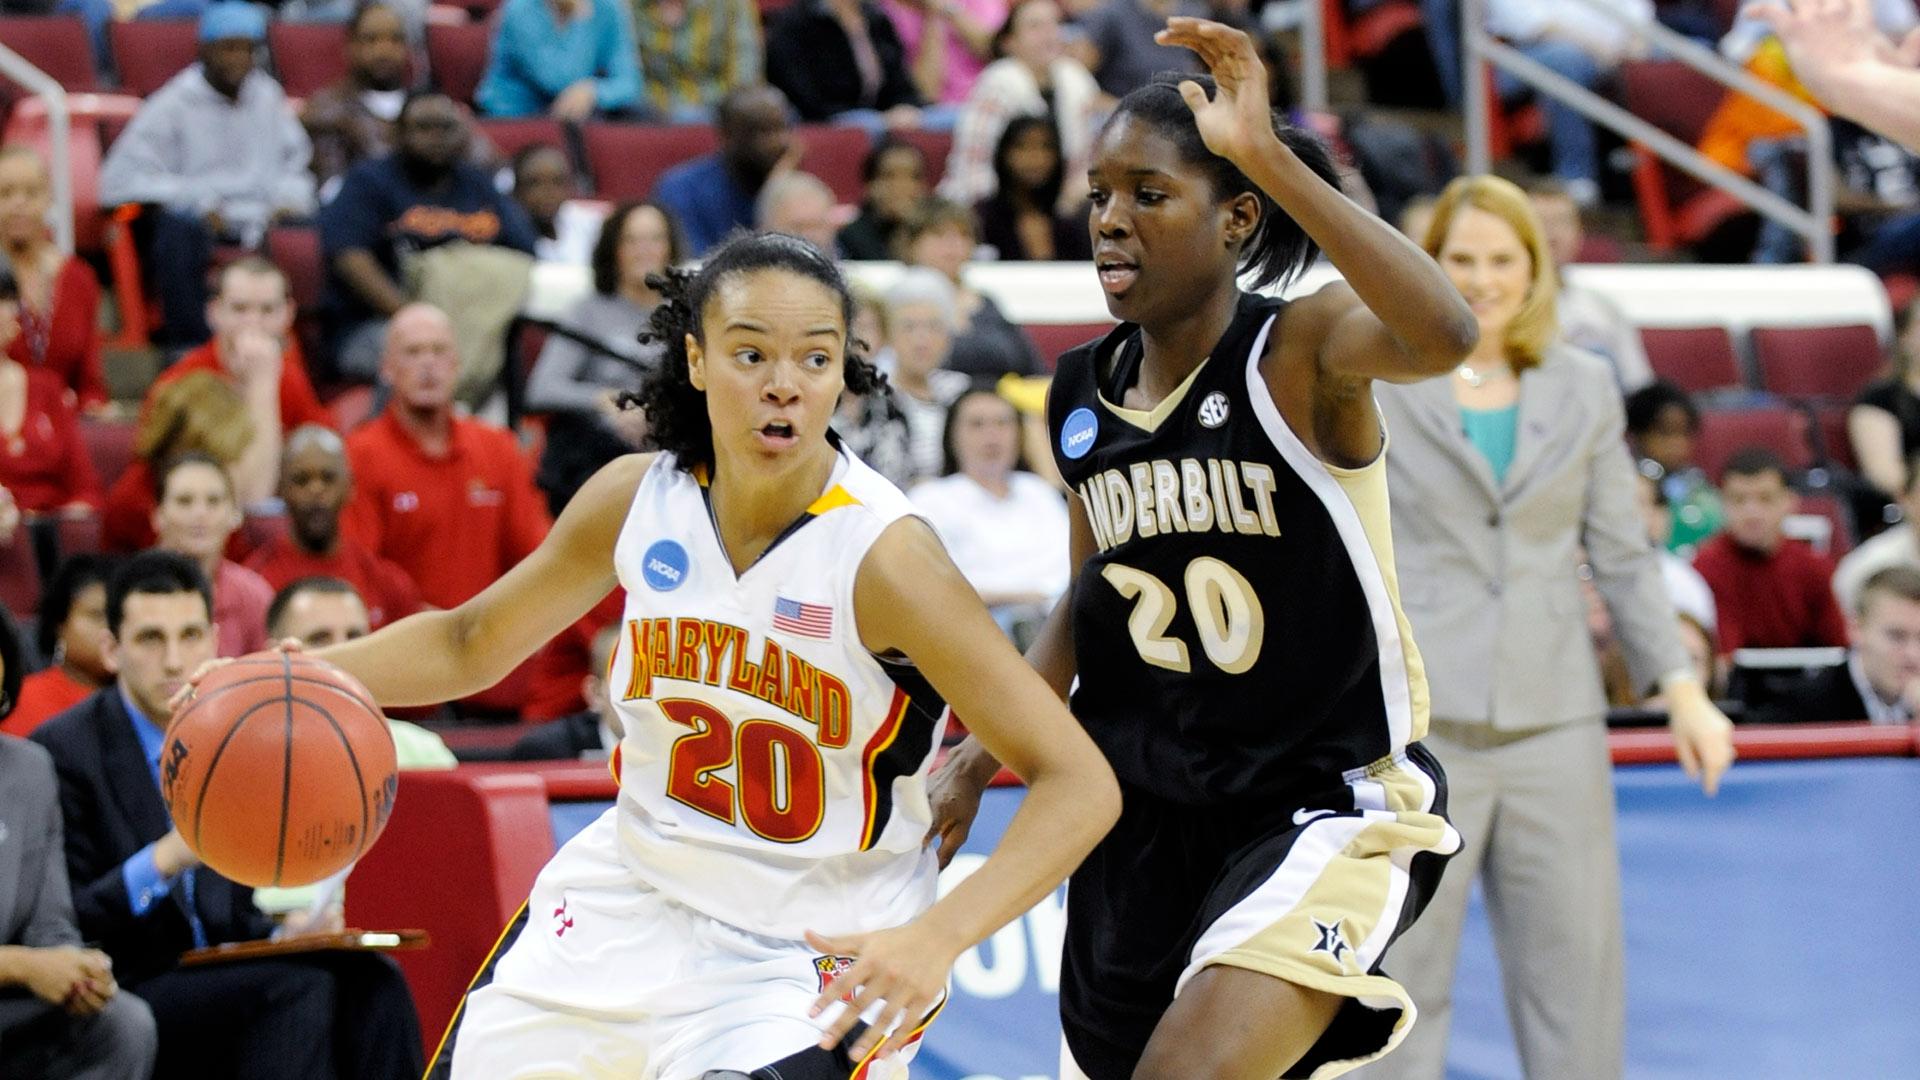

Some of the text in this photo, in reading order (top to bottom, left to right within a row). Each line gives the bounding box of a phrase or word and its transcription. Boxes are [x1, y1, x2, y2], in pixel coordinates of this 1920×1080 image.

[1067, 427, 1094, 448] NCAA
[1199, 392, 1228, 426] SEC
[1079, 458, 1281, 552] NDERBILT
[648, 558, 680, 582] NCAA
[1101, 556, 1264, 674] 20
[622, 617, 851, 749] MARYLAND
[656, 697, 825, 843] 20
